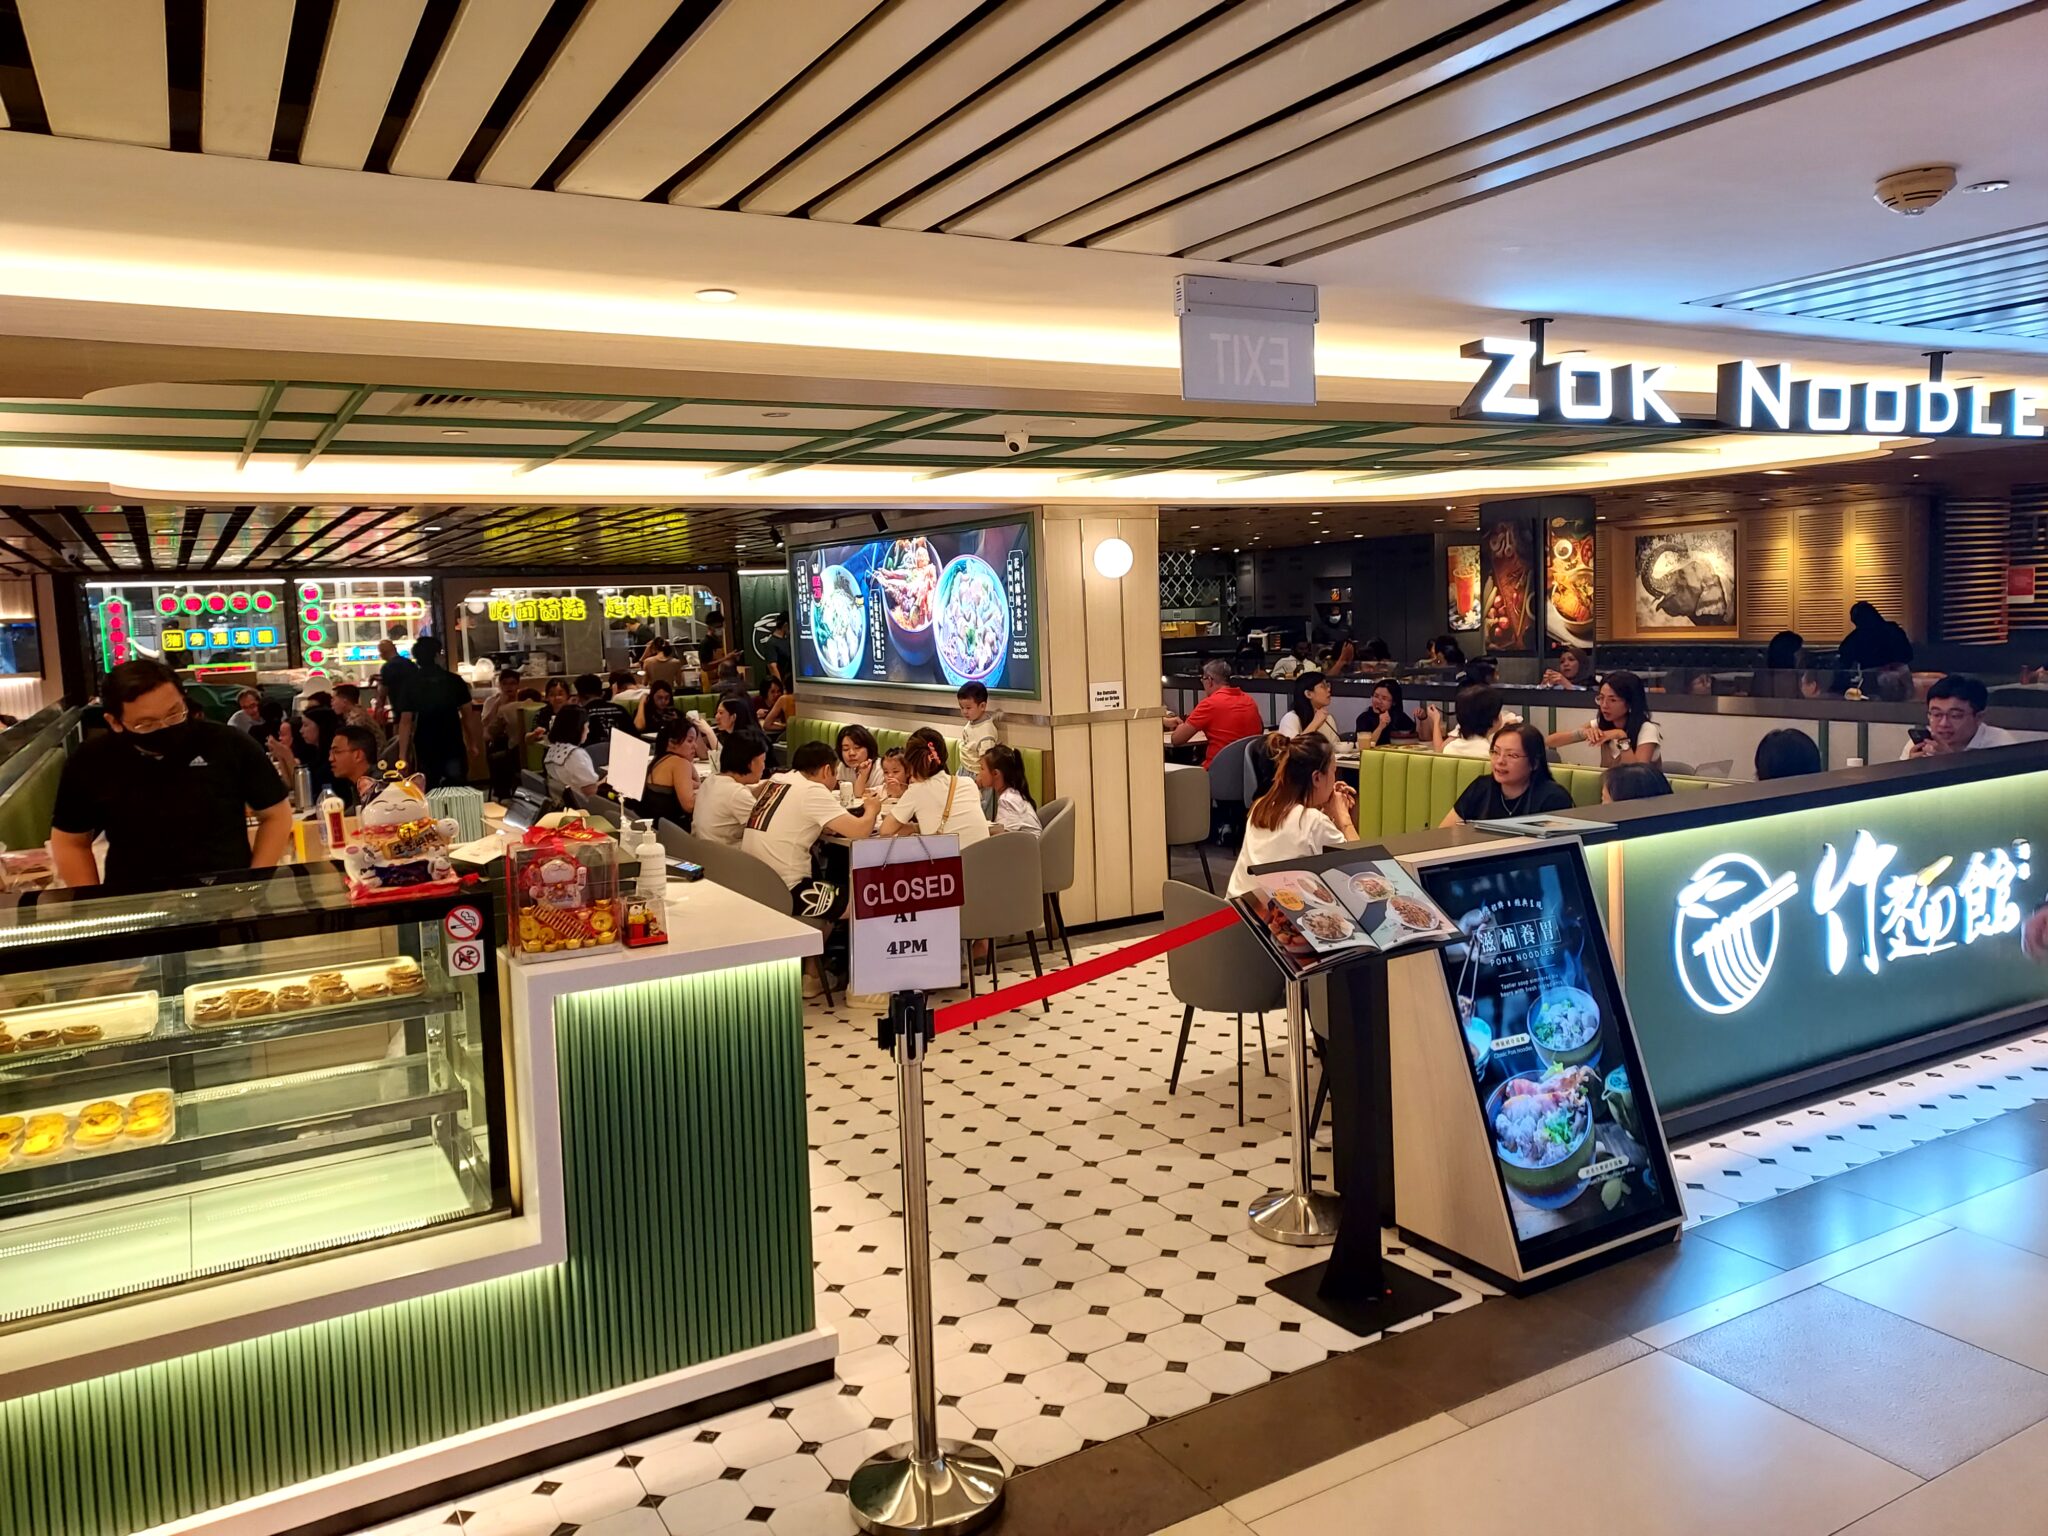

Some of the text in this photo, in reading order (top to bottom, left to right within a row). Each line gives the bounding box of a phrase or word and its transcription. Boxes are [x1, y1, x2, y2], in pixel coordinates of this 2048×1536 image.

[863, 873, 956, 907] CLOSED
[893, 911, 917, 923] AT
[886, 938, 928, 955] 4PM
[1490, 947, 1555, 967] PORK NOODLES
